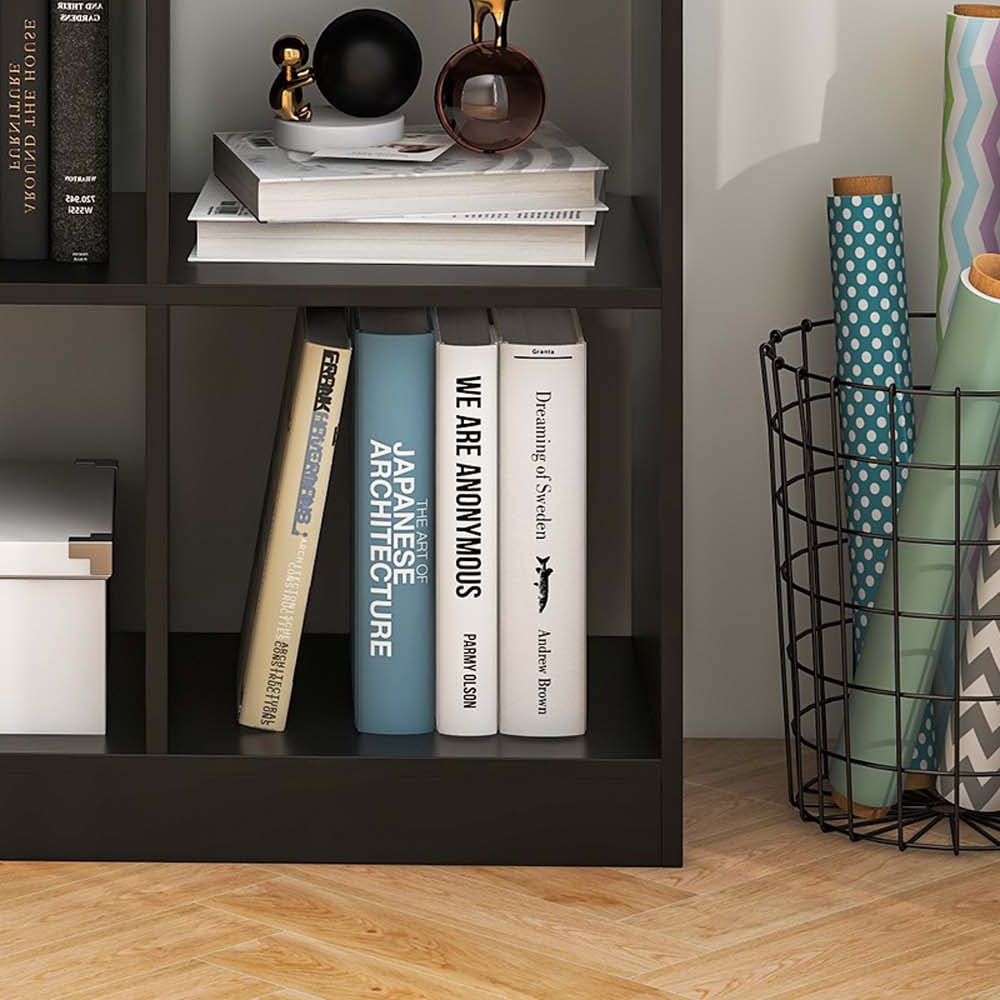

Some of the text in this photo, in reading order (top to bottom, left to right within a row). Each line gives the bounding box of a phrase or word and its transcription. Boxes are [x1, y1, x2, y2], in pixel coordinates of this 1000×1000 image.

[313, 349, 340, 412] FRANK
[455, 375, 482, 599] WE ARE ANONYMOUS
[531, 391, 552, 540] Dreaming of Sweden
[369, 439, 393, 657] ARCHITECTURE
[391, 441, 416, 586] JAPANESE
[415, 498, 429, 584] THE ART OF
[261, 640, 281, 726] CONSTRUCTIONS
[269, 641, 289, 724] ARCHITECTURAL
[463, 633, 477, 709] PARMY OLSON
[537, 629, 552, 715] Andrew Brown
